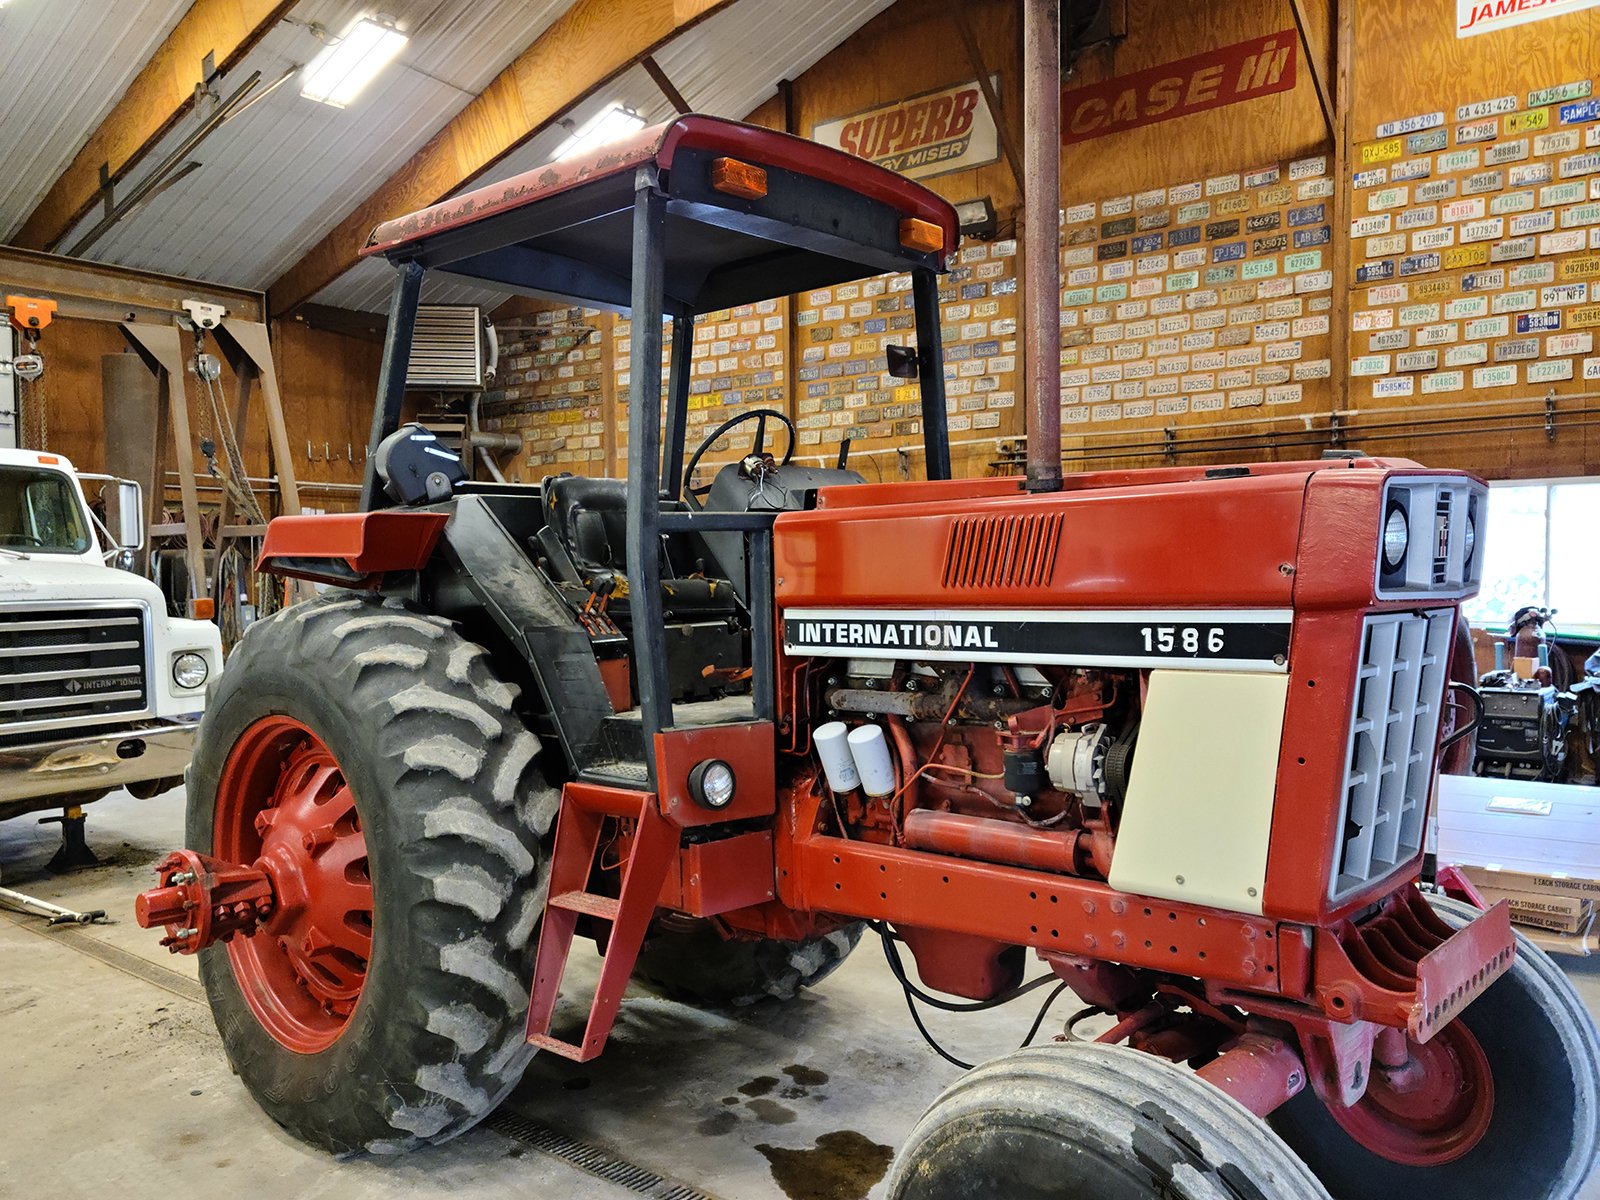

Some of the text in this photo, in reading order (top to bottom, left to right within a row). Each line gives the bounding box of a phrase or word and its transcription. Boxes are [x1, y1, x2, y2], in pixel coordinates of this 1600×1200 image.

[1070, 64, 1226, 134] CASE
[1458, 107, 1470, 120] CA
[1564, 103, 1600, 120] SAMPLE
[840, 89, 978, 160] SUPERB
[1526, 113, 1543, 126] 549
[1382, 124, 1394, 135] ND
[1473, 124, 1494, 136] 7988
[906, 144, 962, 166] MISER
[1543, 292, 1560, 302] 991
[799, 623, 998, 648] INTERNATIONAL
[1141, 627, 1224, 653] 1586
[83, 676, 143, 690] INTERNATIONAL
[1554, 881, 1580, 890] STORAGE
[1520, 901, 1546, 911] STORAGE
[1520, 915, 1544, 926] STORAGE
